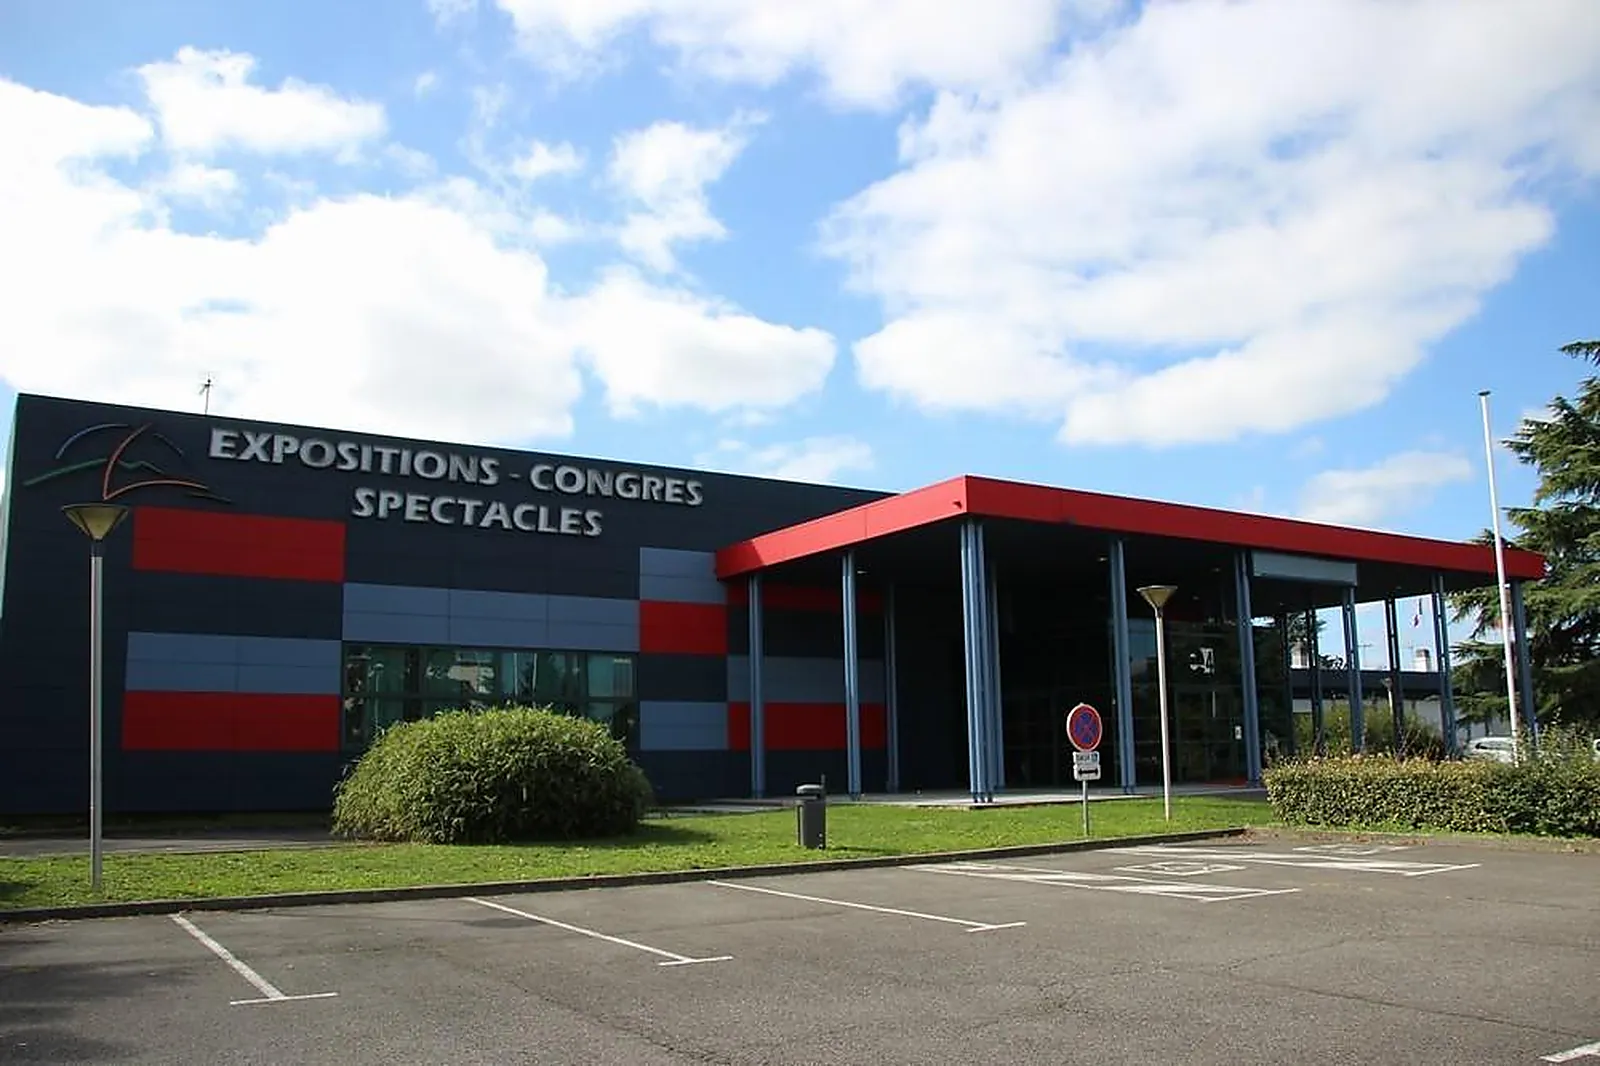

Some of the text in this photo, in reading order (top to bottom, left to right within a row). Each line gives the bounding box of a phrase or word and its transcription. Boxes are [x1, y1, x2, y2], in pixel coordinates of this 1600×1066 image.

[208, 428, 499, 486] EXPOSITIONS
[529, 463, 704, 507] CONGRES
[352, 487, 604, 537] SPECTACLES
